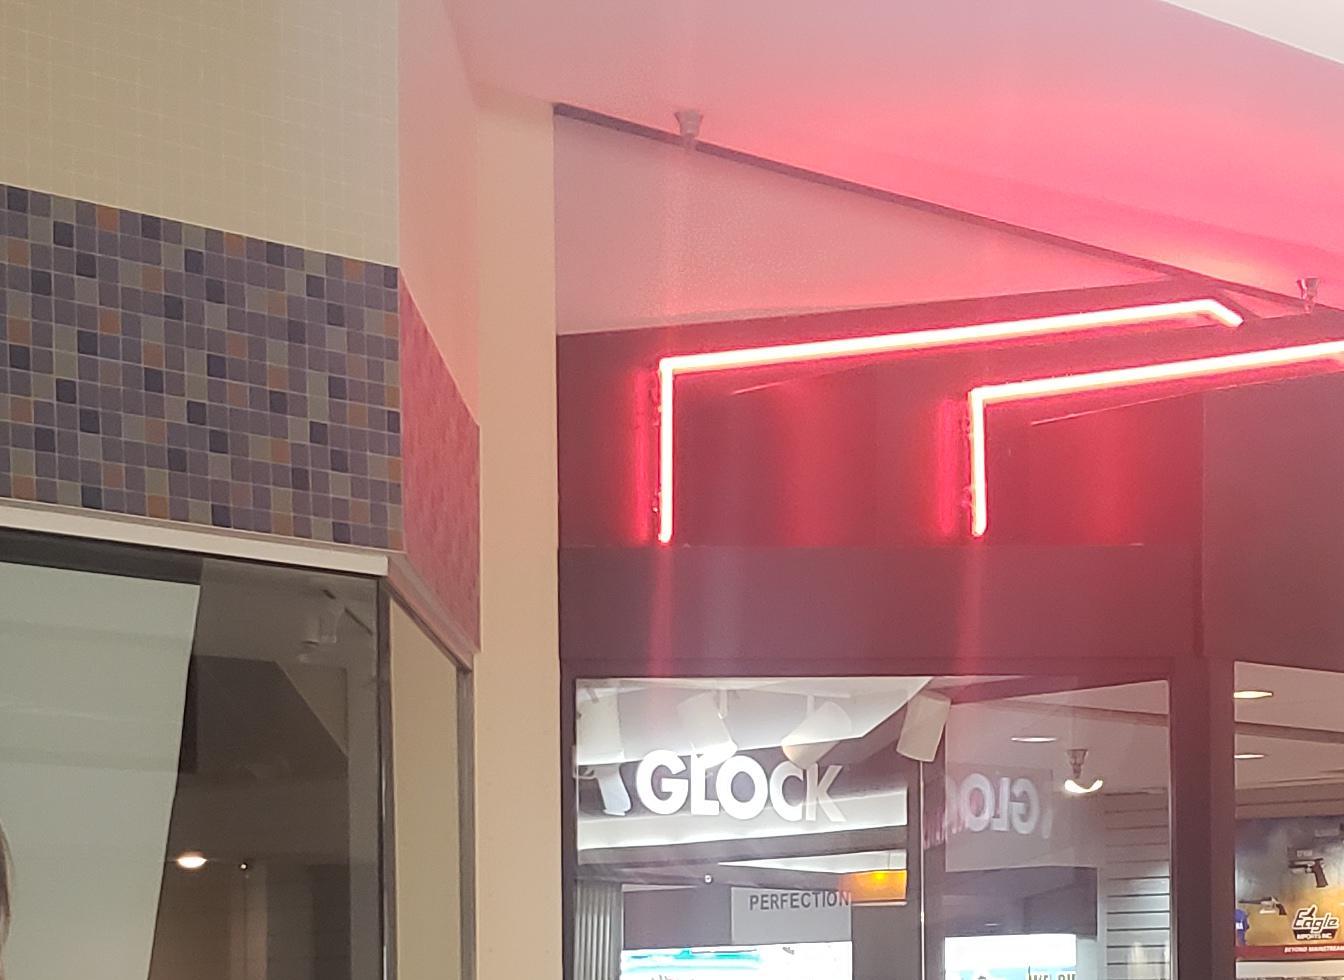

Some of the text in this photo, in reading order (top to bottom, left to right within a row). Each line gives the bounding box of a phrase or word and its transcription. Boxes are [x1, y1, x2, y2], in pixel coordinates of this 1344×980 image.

[635, 749, 847, 822] GLOCK
[749, 891, 850, 911] PERFECTION
[1292, 905, 1338, 933] Eagle
